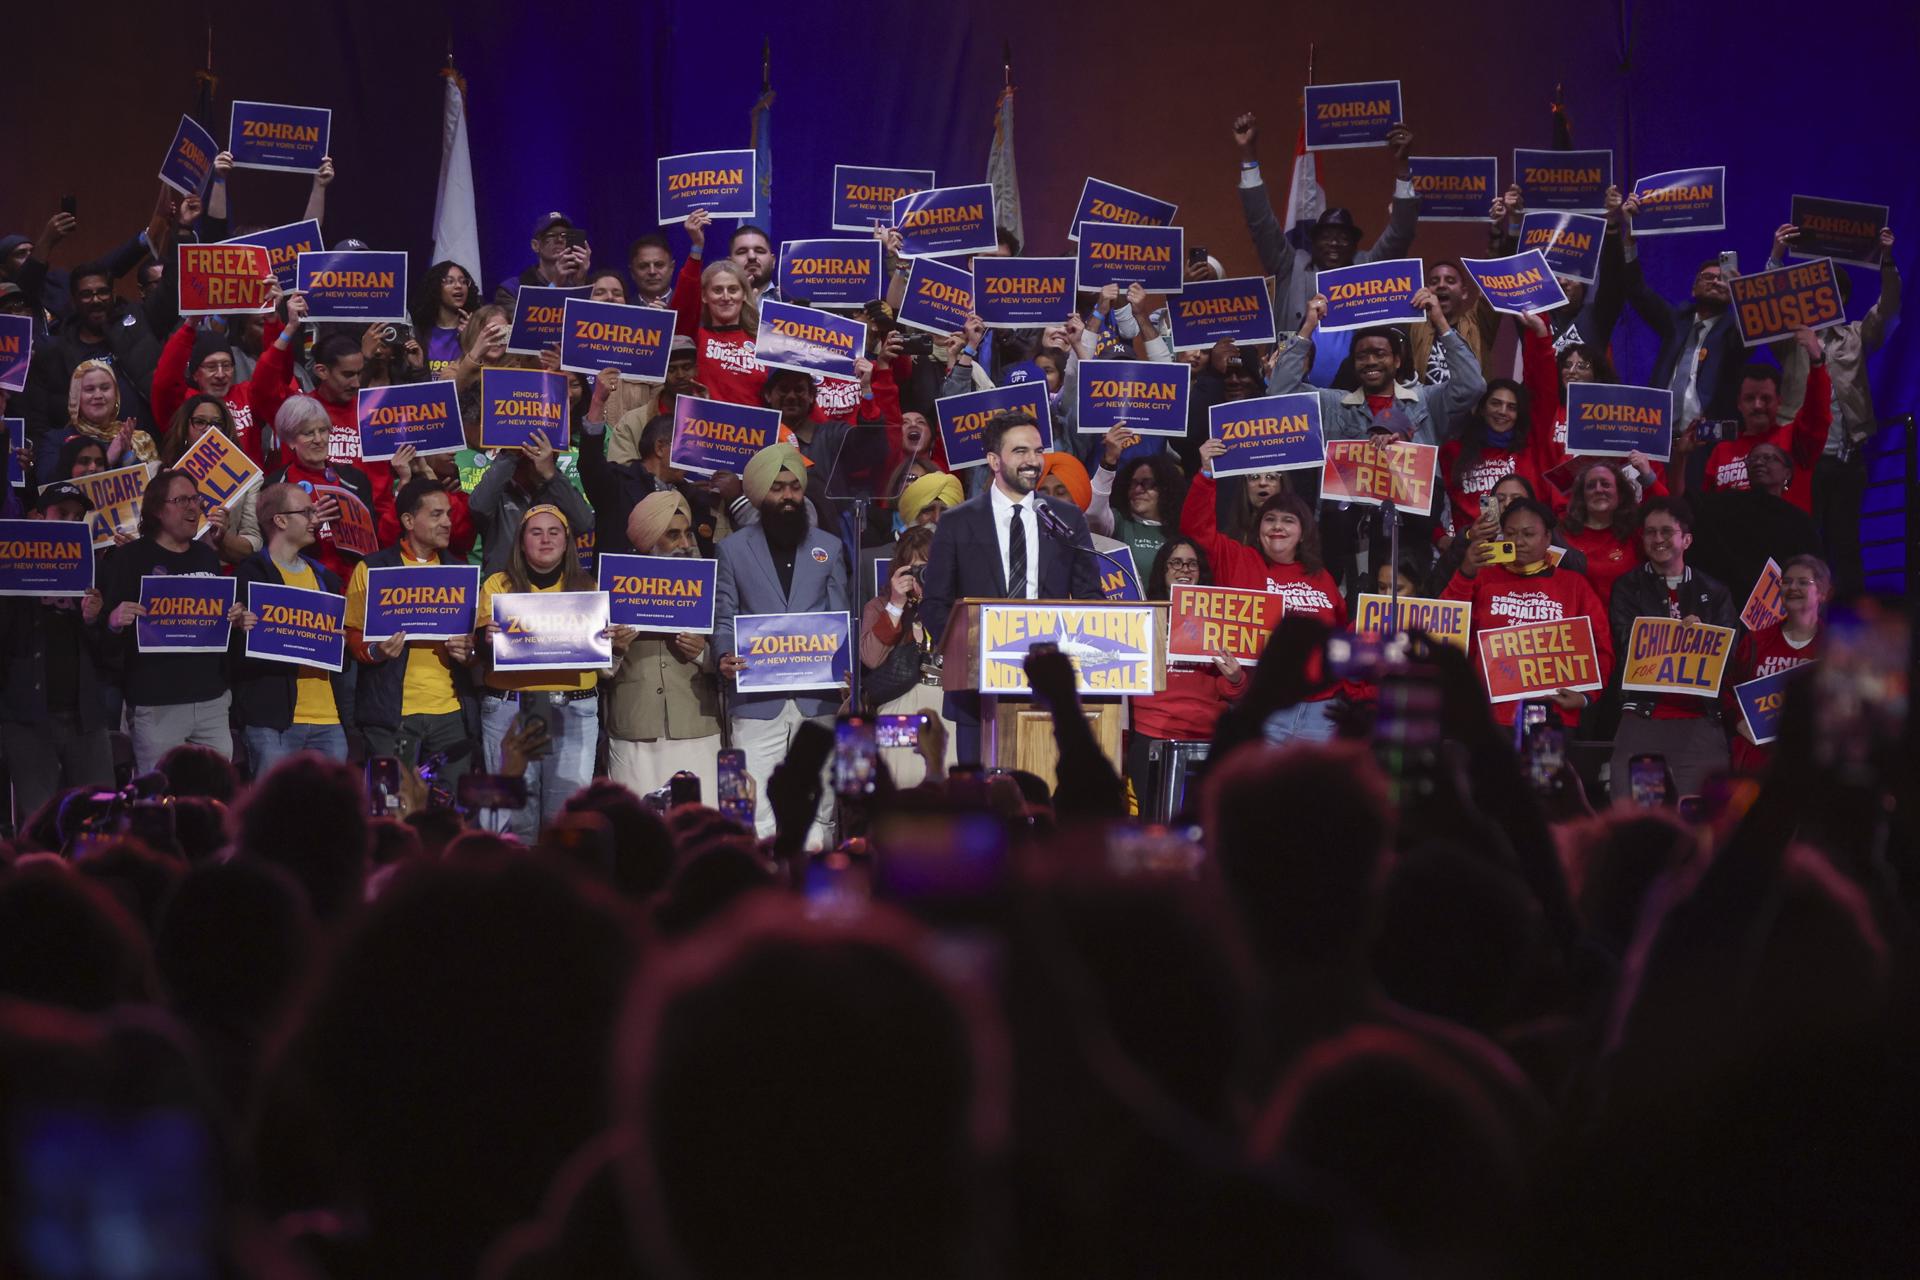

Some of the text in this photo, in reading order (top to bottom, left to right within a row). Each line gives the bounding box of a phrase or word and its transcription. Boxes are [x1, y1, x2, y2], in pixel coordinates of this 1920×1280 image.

[1316, 99, 1390, 120] ZOHRAN
[241, 119, 319, 142] ZOHRAN
[667, 167, 743, 190] ZOHRAN
[1410, 174, 1486, 191] ZOHRAN
[1524, 167, 1601, 183] ZOHRAN
[699, 188, 719, 196] YORK
[720, 186, 739, 194] CITY
[1641, 184, 1713, 204] ZOHRAN
[902, 203, 983, 228] ZOHRAN
[1801, 212, 1876, 238] ZOHRAN
[1525, 229, 1592, 251] ZOHRAN
[187, 249, 259, 276] FREEZE
[1089, 241, 1170, 263] ZOHRAN
[789, 257, 870, 275] ZOHRAN
[1104, 262, 1122, 270] NEW
[1124, 263, 1146, 271] YORK
[309, 270, 394, 288] ZOHRAN
[984, 276, 1065, 294] ZOHRAN
[1328, 275, 1411, 301] ZOHRAN
[1478, 267, 1543, 290] ZOHRAN
[1734, 262, 1831, 302] FAST FREE
[208, 276, 266, 304] RENT
[1345, 293, 1408, 307] NEW YORK CITY
[931, 301, 949, 311] NEW
[1178, 294, 1259, 317] ZOHRAN
[1741, 286, 1838, 336] BUSES
[573, 318, 661, 347] ZOHRAN
[770, 317, 853, 348] ZOHRAN
[589, 343, 655, 357] NEW YORK CITY
[1011, 375, 1027, 383] UFT
[1089, 379, 1176, 400] ZOHRAN
[512, 391, 539, 399] HINDUS
[1127, 401, 1150, 409] YORK
[1151, 402, 1171, 410] CITY
[367, 401, 447, 426] ZOHRAN
[494, 399, 561, 420] ZOHRAN
[1579, 401, 1662, 425] ZOHRAN
[384, 422, 445, 434] NEW YORK CITY
[528, 419, 546, 427] YORK
[546, 421, 559, 429] CITY
[682, 416, 765, 447] ZOHRAN
[1220, 413, 1309, 440] ZOHRAN
[1239, 435, 1306, 449] NEW YORK CITY
[559, 456, 574, 474] 7
[1335, 443, 1418, 475] FREEZE
[1356, 466, 1427, 504] RENT
[0, 540, 81, 559] ZOHRAN
[379, 585, 465, 605] ZOHRAN
[612, 574, 703, 598] ZOHRAN
[1287, 581, 1301, 589] York
[1301, 582, 1312, 591] City
[1507, 591, 1522, 599] New
[1536, 592, 1549, 601] City
[148, 596, 223, 616] ZOHRAN
[629, 597, 697, 608] NEW YORK CITY
[1180, 591, 1266, 625] FREEZE
[1490, 602, 1563, 620] SOCIALISTS
[1492, 595, 1563, 610] DEMOCRATIC
[177, 618, 197, 626] YORK
[198, 619, 218, 627] CITY
[262, 604, 337, 634] ZOHRAN
[507, 614, 598, 634] ZOHRAN
[1365, 601, 1463, 635] CHILDCARE
[1508, 617, 1515, 626] of
[276, 626, 333, 643] NEW YORK CITY
[524, 635, 544, 644] NEW
[987, 610, 1057, 651] NEW
[1061, 611, 1148, 653] YORK
[1202, 622, 1272, 655] RENT
[1489, 624, 1575, 658] FREEZE
[1634, 622, 1726, 661] CHILDCARE
[749, 633, 837, 655] ZOHRAN
[767, 654, 834, 664] NEW YORK CITY
[985, 658, 1029, 688] NOT
[1090, 660, 1148, 689] SALE
[1518, 654, 1590, 687] RENT
[1632, 656, 1712, 687] FOR ALL
